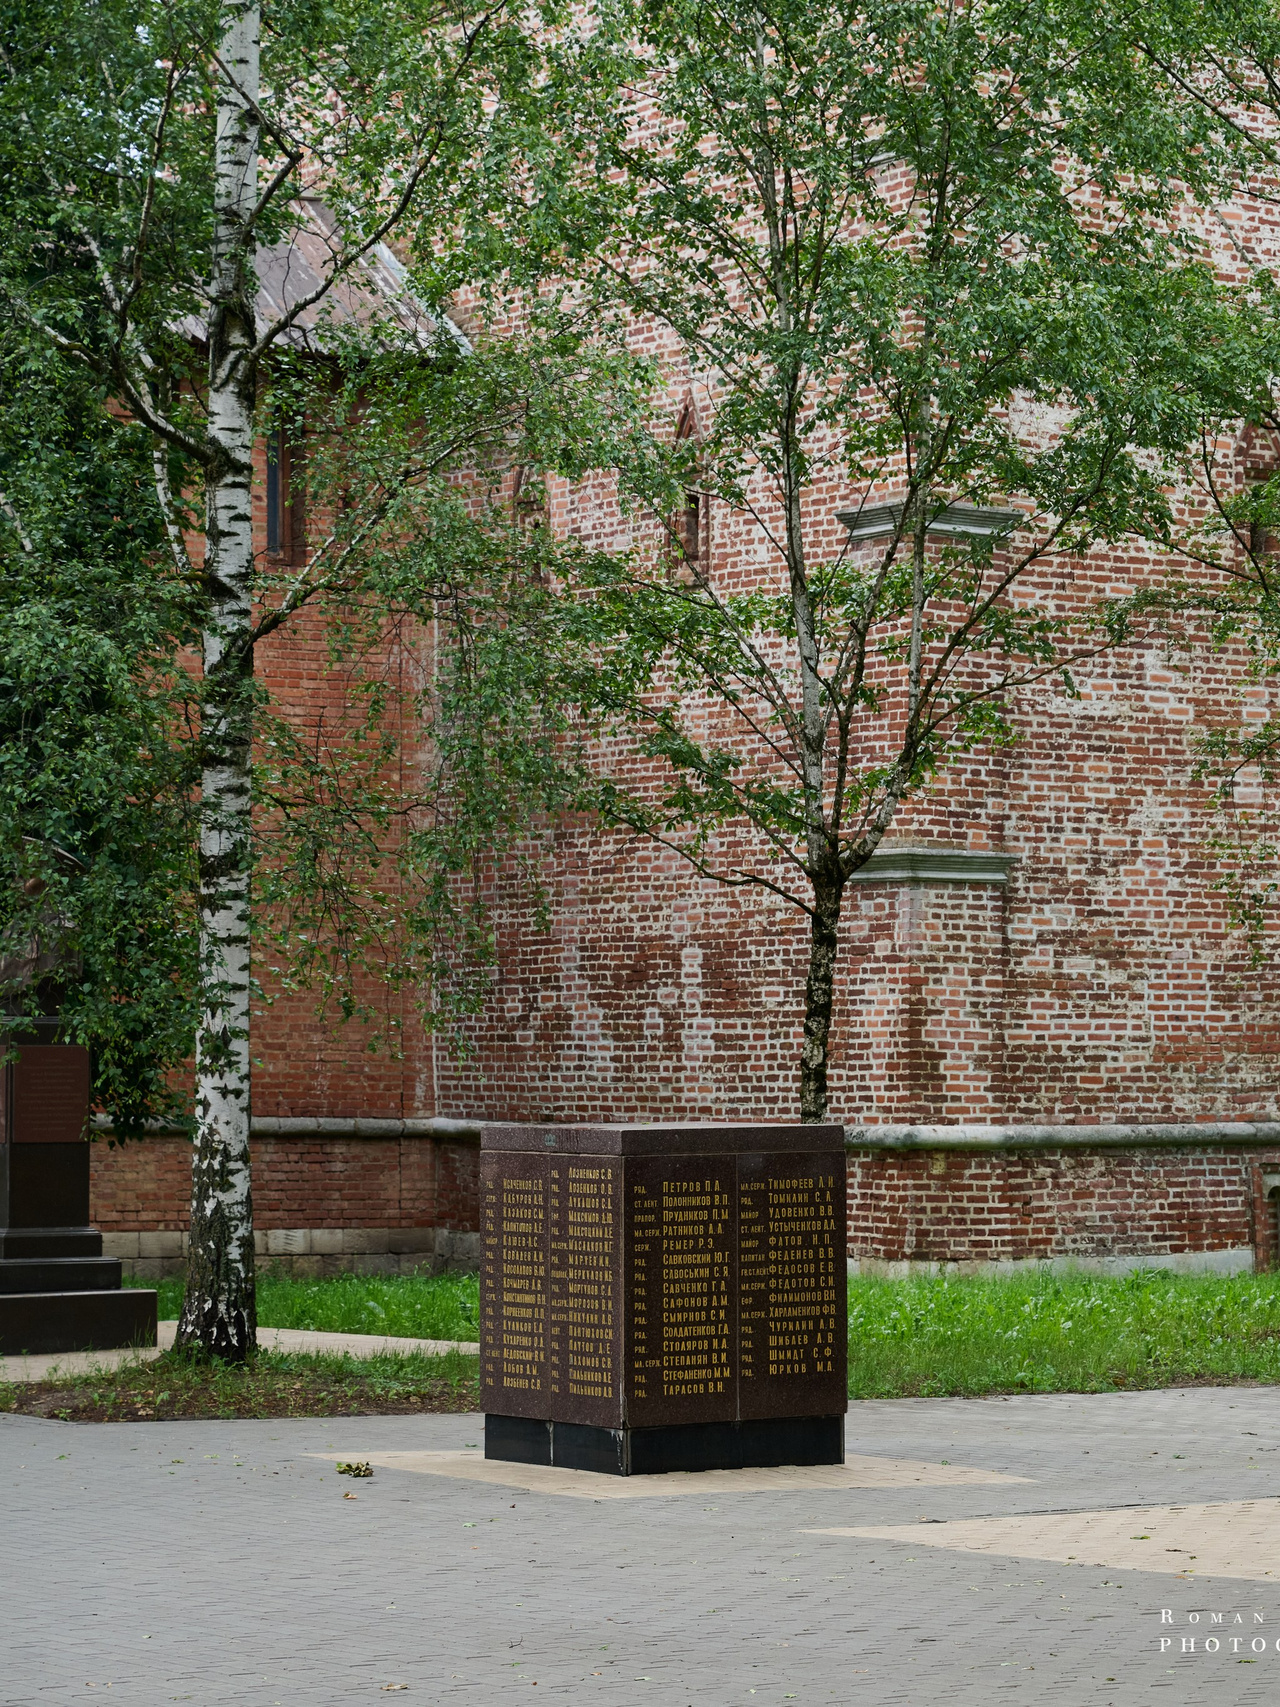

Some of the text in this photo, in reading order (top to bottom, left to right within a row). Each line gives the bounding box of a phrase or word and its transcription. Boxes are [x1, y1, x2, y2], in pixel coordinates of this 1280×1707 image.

[663, 1181, 701, 1193] ПЕТРОВ
[768, 1178, 814, 1190] ТИМОФЕЕВ
[663, 1196, 711, 1207] ПОЛОННИКОВ
[768, 1193, 809, 1204] ТОМИЛИН
[503, 1206, 532, 1219] КАЗАКОВ
[663, 1210, 708, 1222] ПРУДНИКОВ
[768, 1207, 815, 1219] УДОВЕНКО
[663, 1225, 704, 1236] РАТНИКОВ
[768, 1221, 822, 1233] УСТЫЧЕНКОВ
[663, 1240, 694, 1251] РЕМЕР
[768, 1236, 802, 1246] ФАТОВ
[768, 1249, 814, 1261] ФЕДЕНЕВ
[663, 1267, 710, 1280] САВОСЬКИН
[769, 1263, 815, 1275] ФЕДОСОВ
[663, 1282, 708, 1294] САВЧЕНКО
[769, 1278, 815, 1290] ФЕДОТОВ
[569, 1297, 599, 1309] МОРОЗОВ
[663, 1296, 708, 1309] САФОНОВ
[769, 1291, 822, 1303] ФИЛИМОНОВ
[663, 1311, 706, 1323] СМИРНОВ
[769, 1306, 820, 1318] ХАРЛАМЕНКОВ
[663, 1325, 716, 1338] СОЛДАТЕНКОВ
[769, 1320, 814, 1332] ЧУРИЛИН
[663, 1340, 709, 1352] СТОЛЯРОВ
[663, 1354, 708, 1367] СТЕПАНЯН
[769, 1349, 804, 1361] ШМИДТ
[503, 1362, 524, 1374] ЛОБОВ
[769, 1363, 807, 1375] ЮРКОВ
[663, 1369, 712, 1381] СТЕФАНЕНКО
[663, 1383, 705, 1396] ТАРАСОВ
